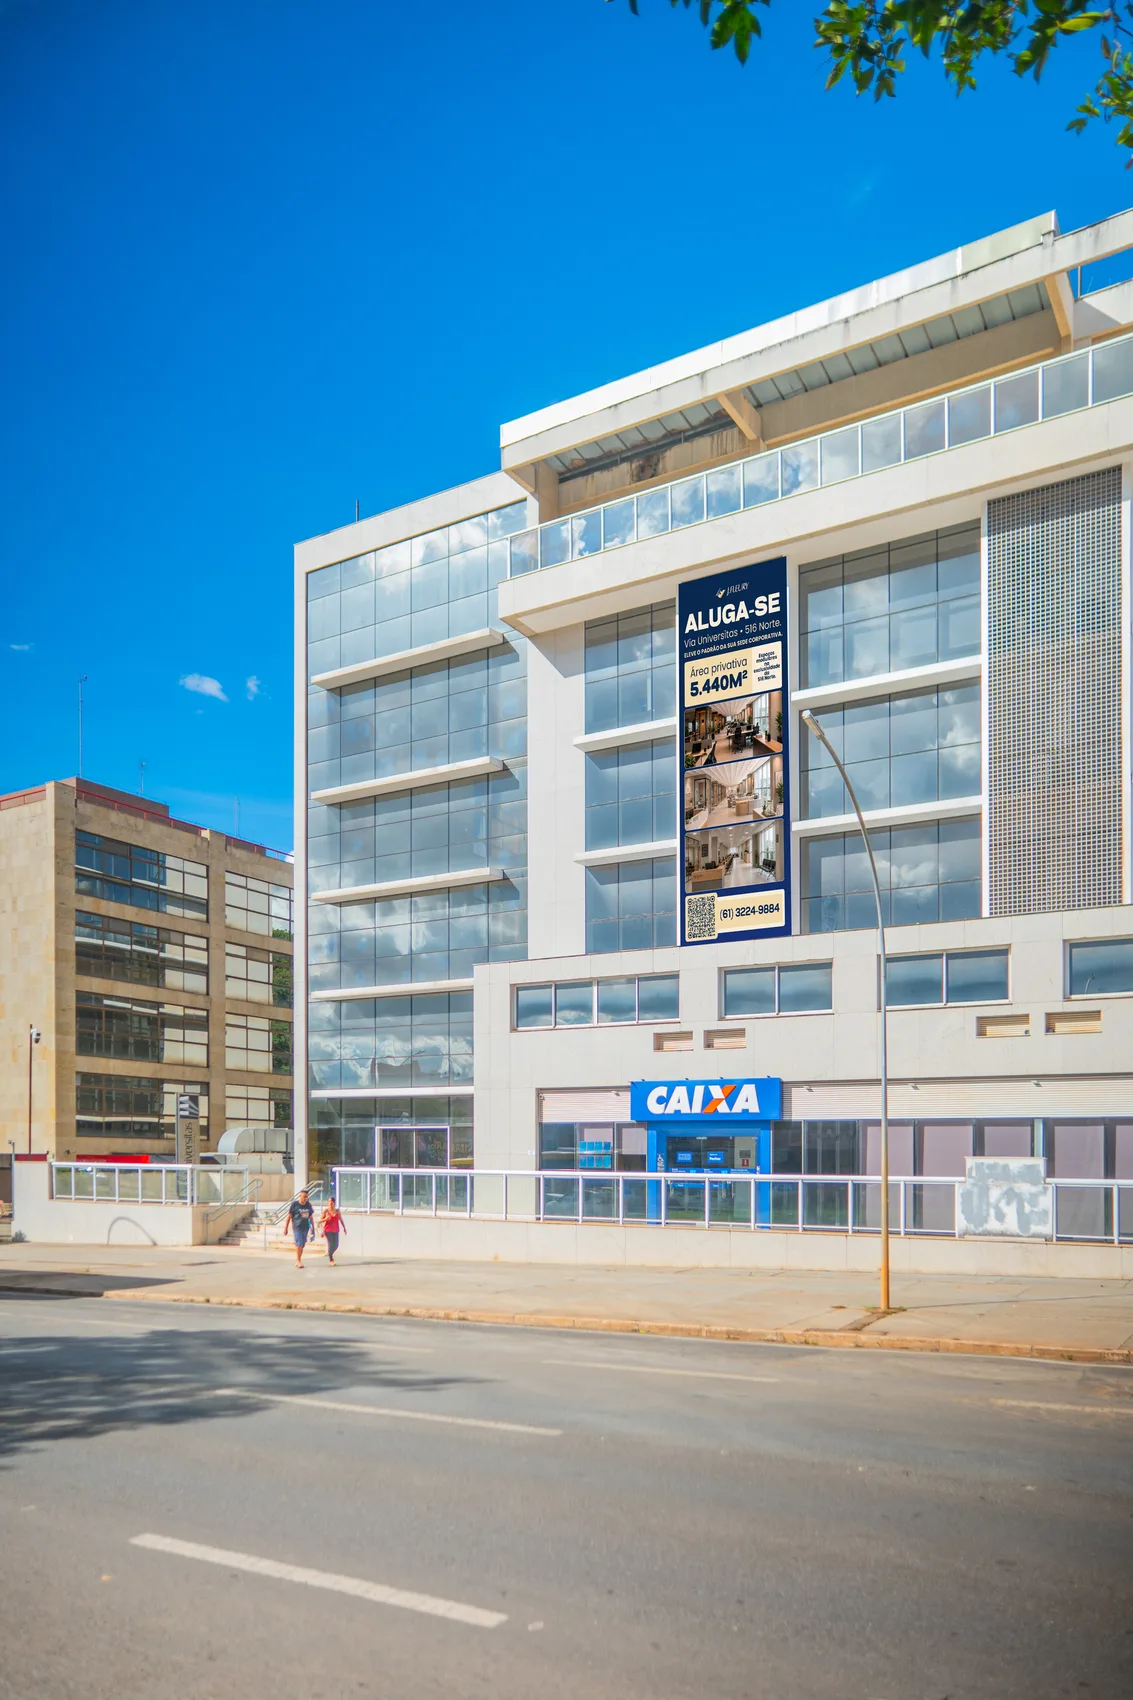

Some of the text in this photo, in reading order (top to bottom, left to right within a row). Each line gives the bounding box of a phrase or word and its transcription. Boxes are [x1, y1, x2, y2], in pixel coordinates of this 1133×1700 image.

[684, 592, 781, 634] ALUGA-SE
[684, 619, 782, 648] Via Universitas 516 Norte.
[684, 650, 697, 658] ELEVE
[701, 644, 720, 655] PADRÃO
[727, 641, 737, 649] SUA
[737, 638, 748, 647] SEDE
[690, 657, 748, 678] Área privativa
[719, 903, 780, 921] (61) 3224-9884
[646, 1083, 760, 1115] CAIXA
